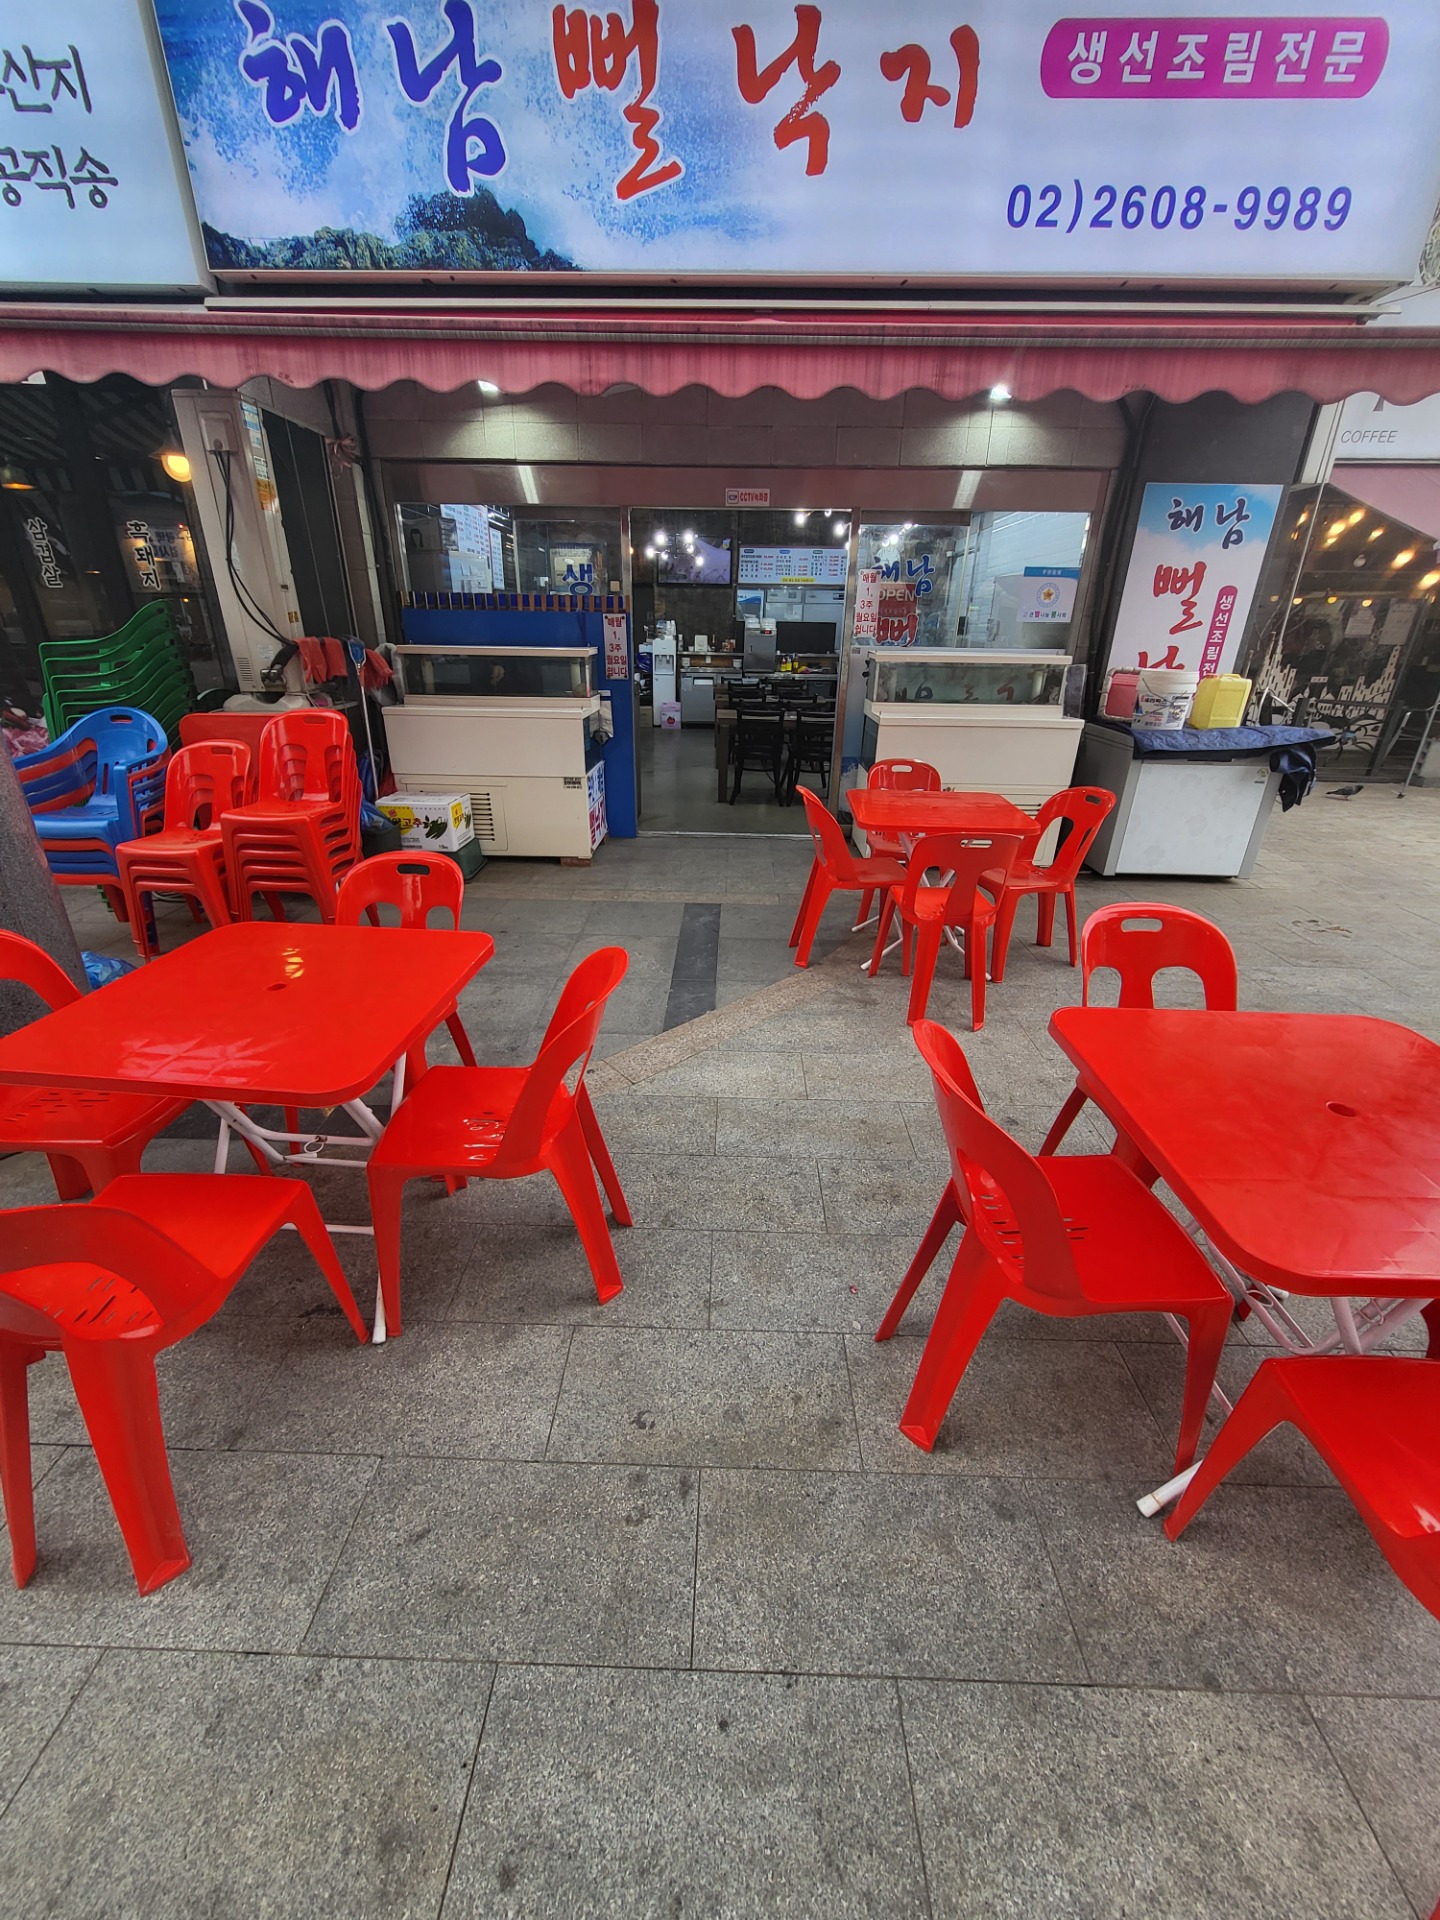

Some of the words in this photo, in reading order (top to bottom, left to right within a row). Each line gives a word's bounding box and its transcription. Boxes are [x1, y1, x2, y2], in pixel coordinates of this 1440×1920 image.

[1067, 30, 1366, 86] 생선조림전문
[0, 44, 92, 115] 산지
[241, 0, 502, 194] 해남
[1006, 179, 1353, 234] 02)2608-9989
[1341, 430, 1398, 443] COFFEE
[1168, 498, 1250, 550] 해남
[28, 517, 63, 588] 삼겹살
[127, 520, 162, 590] 흑돼지
[562, 563, 593, 595] 생
[863, 572, 877, 583] 매월
[856, 612, 877, 622] 월요일
[860, 600, 873, 609] 3주
[607, 655, 627, 665] 월요일
[609, 643, 622, 652] 3주
